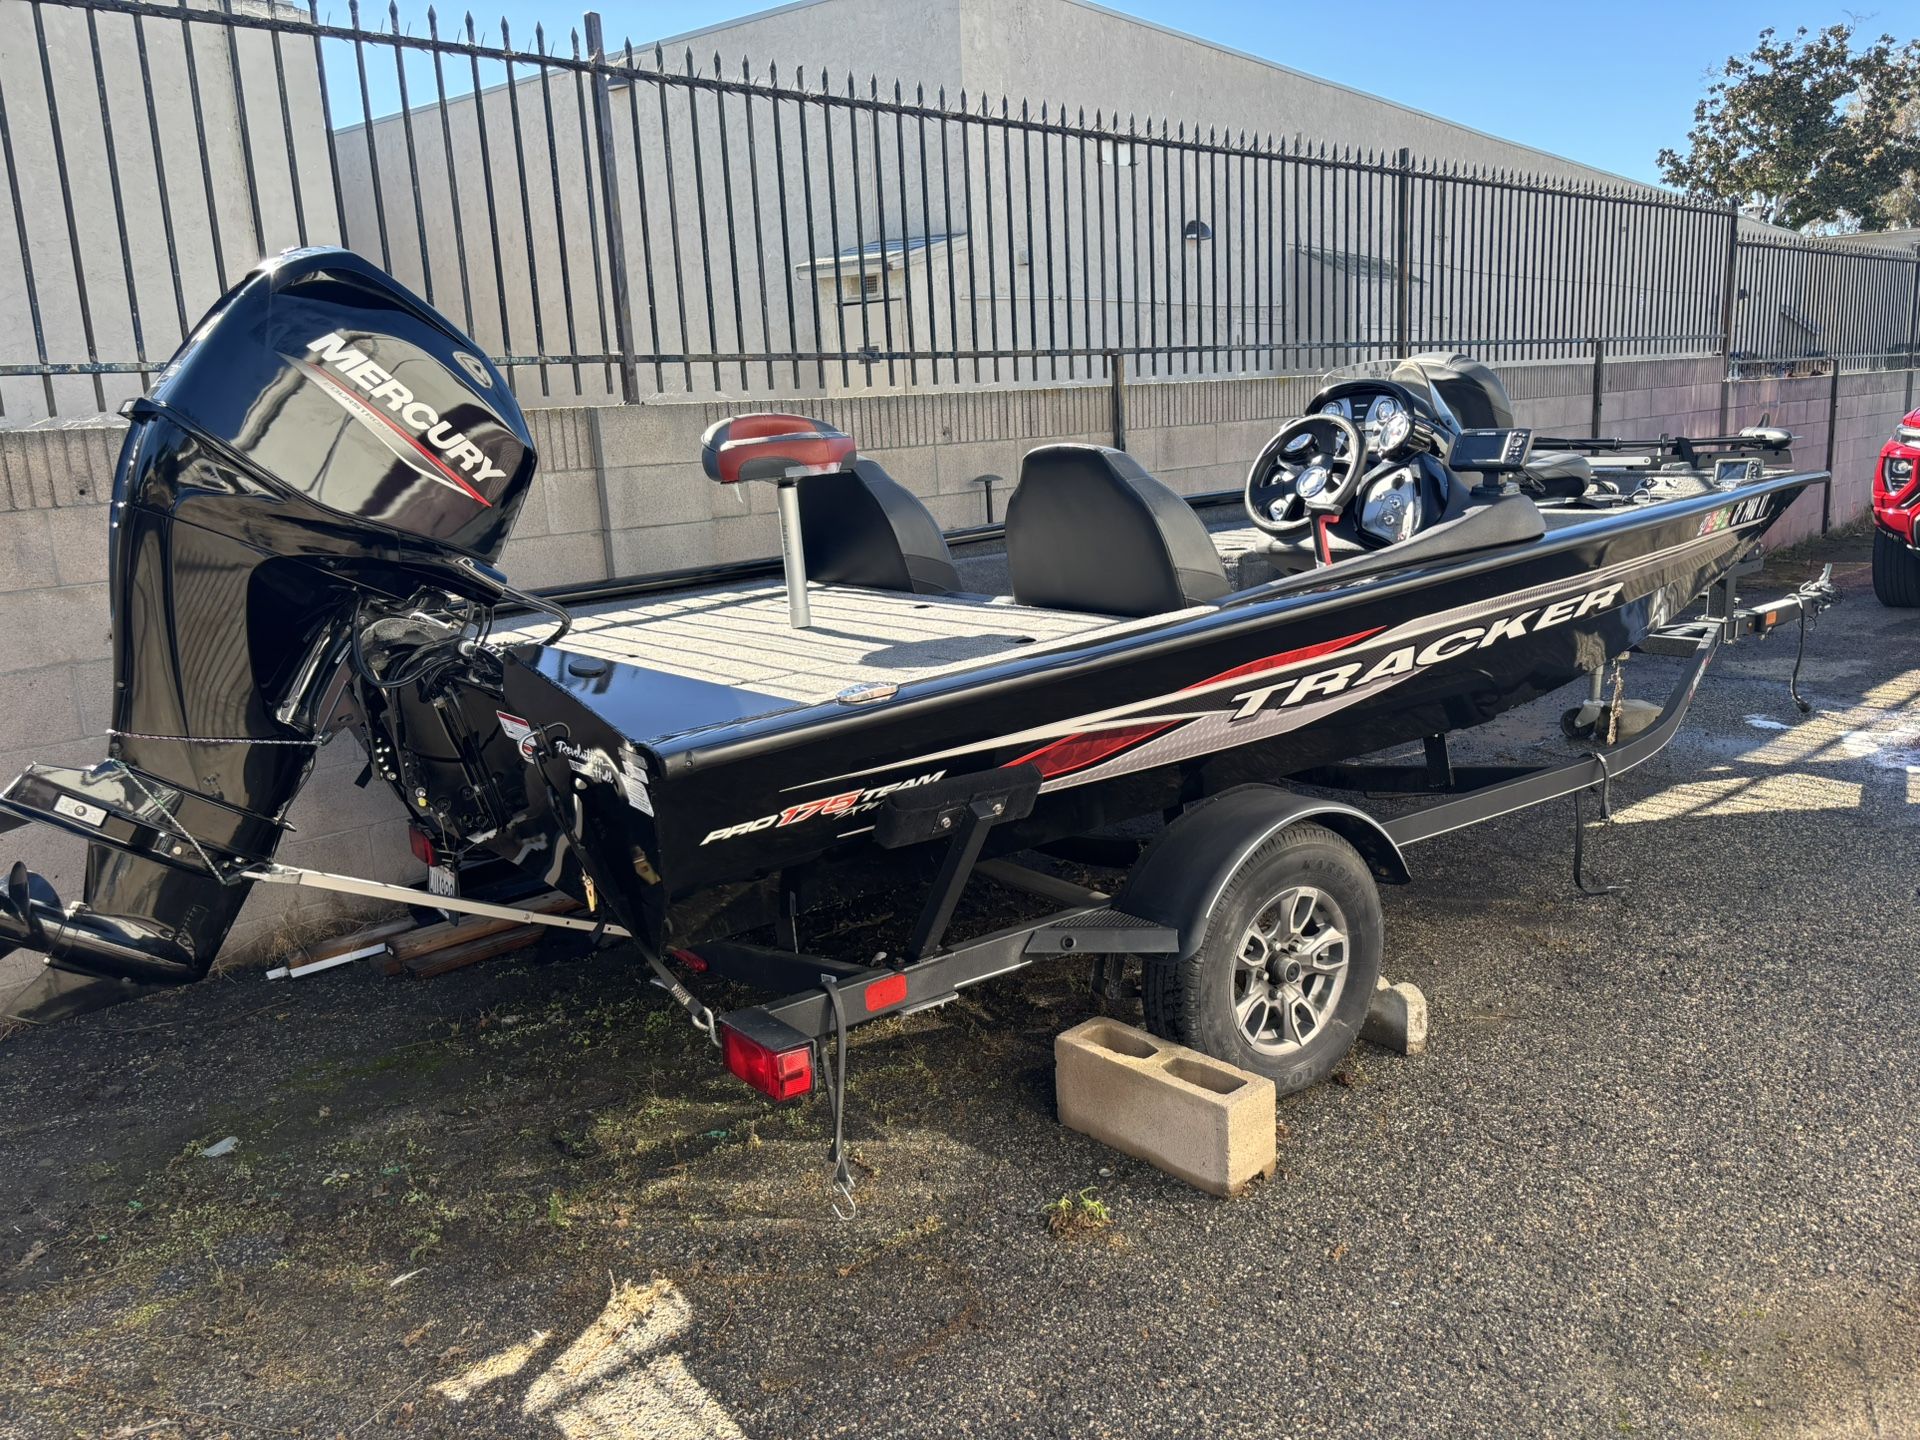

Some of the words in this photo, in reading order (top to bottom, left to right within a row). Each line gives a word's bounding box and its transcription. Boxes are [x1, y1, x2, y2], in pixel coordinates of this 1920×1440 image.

[306, 332, 507, 482] MERCURY
[1229, 582, 1625, 723] TRACKER
[699, 814, 778, 846] PRO
[776, 788, 866, 828] 175
[862, 769, 948, 802] TEAM
